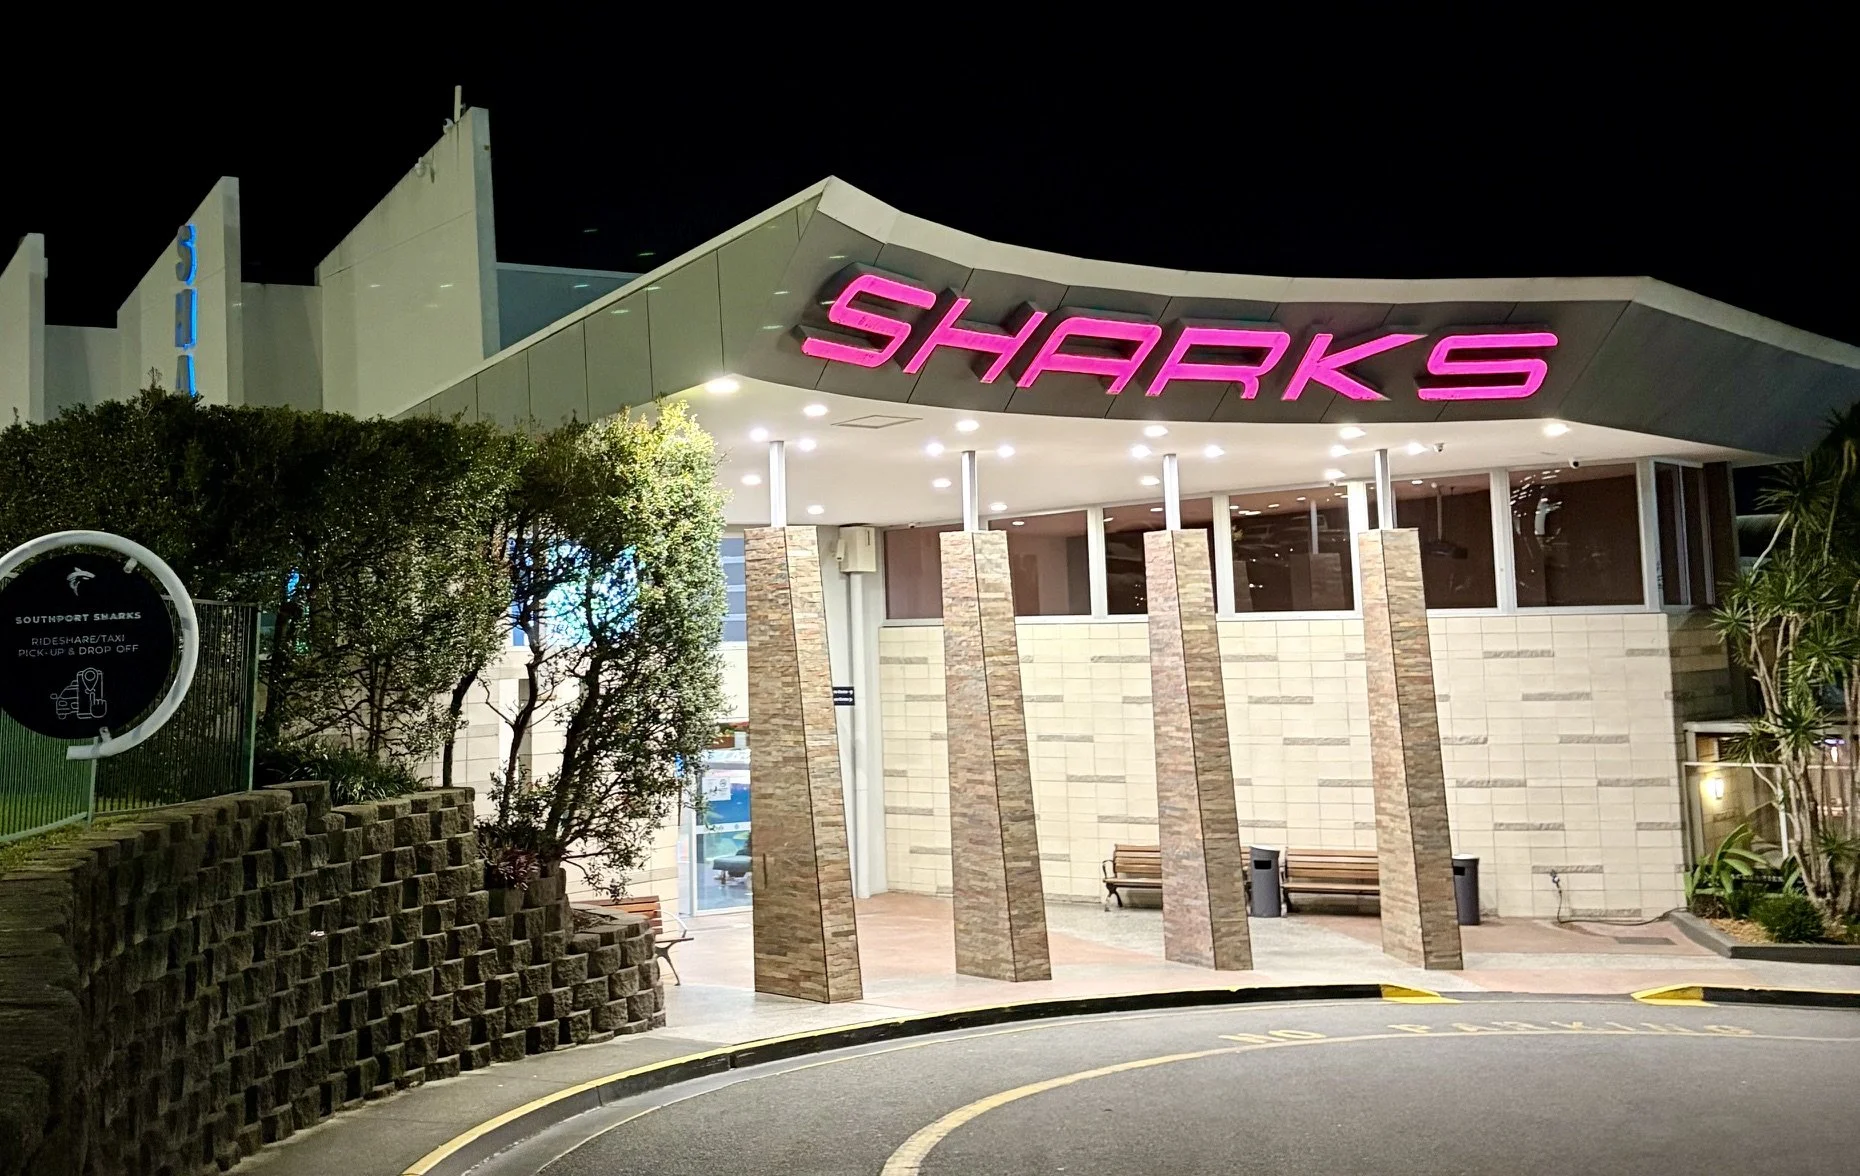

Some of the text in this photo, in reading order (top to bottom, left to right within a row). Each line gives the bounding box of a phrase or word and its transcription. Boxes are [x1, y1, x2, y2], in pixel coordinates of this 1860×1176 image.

[801, 273, 1560, 402] SHARKS
[15, 611, 142, 624] SOUTHPORT SHARKS
[31, 634, 125, 645] RIDESHARE/TAXI
[18, 644, 139, 657] PICK-UP & DROP OFF
[1217, 1021, 1755, 1044] NO PARKING
